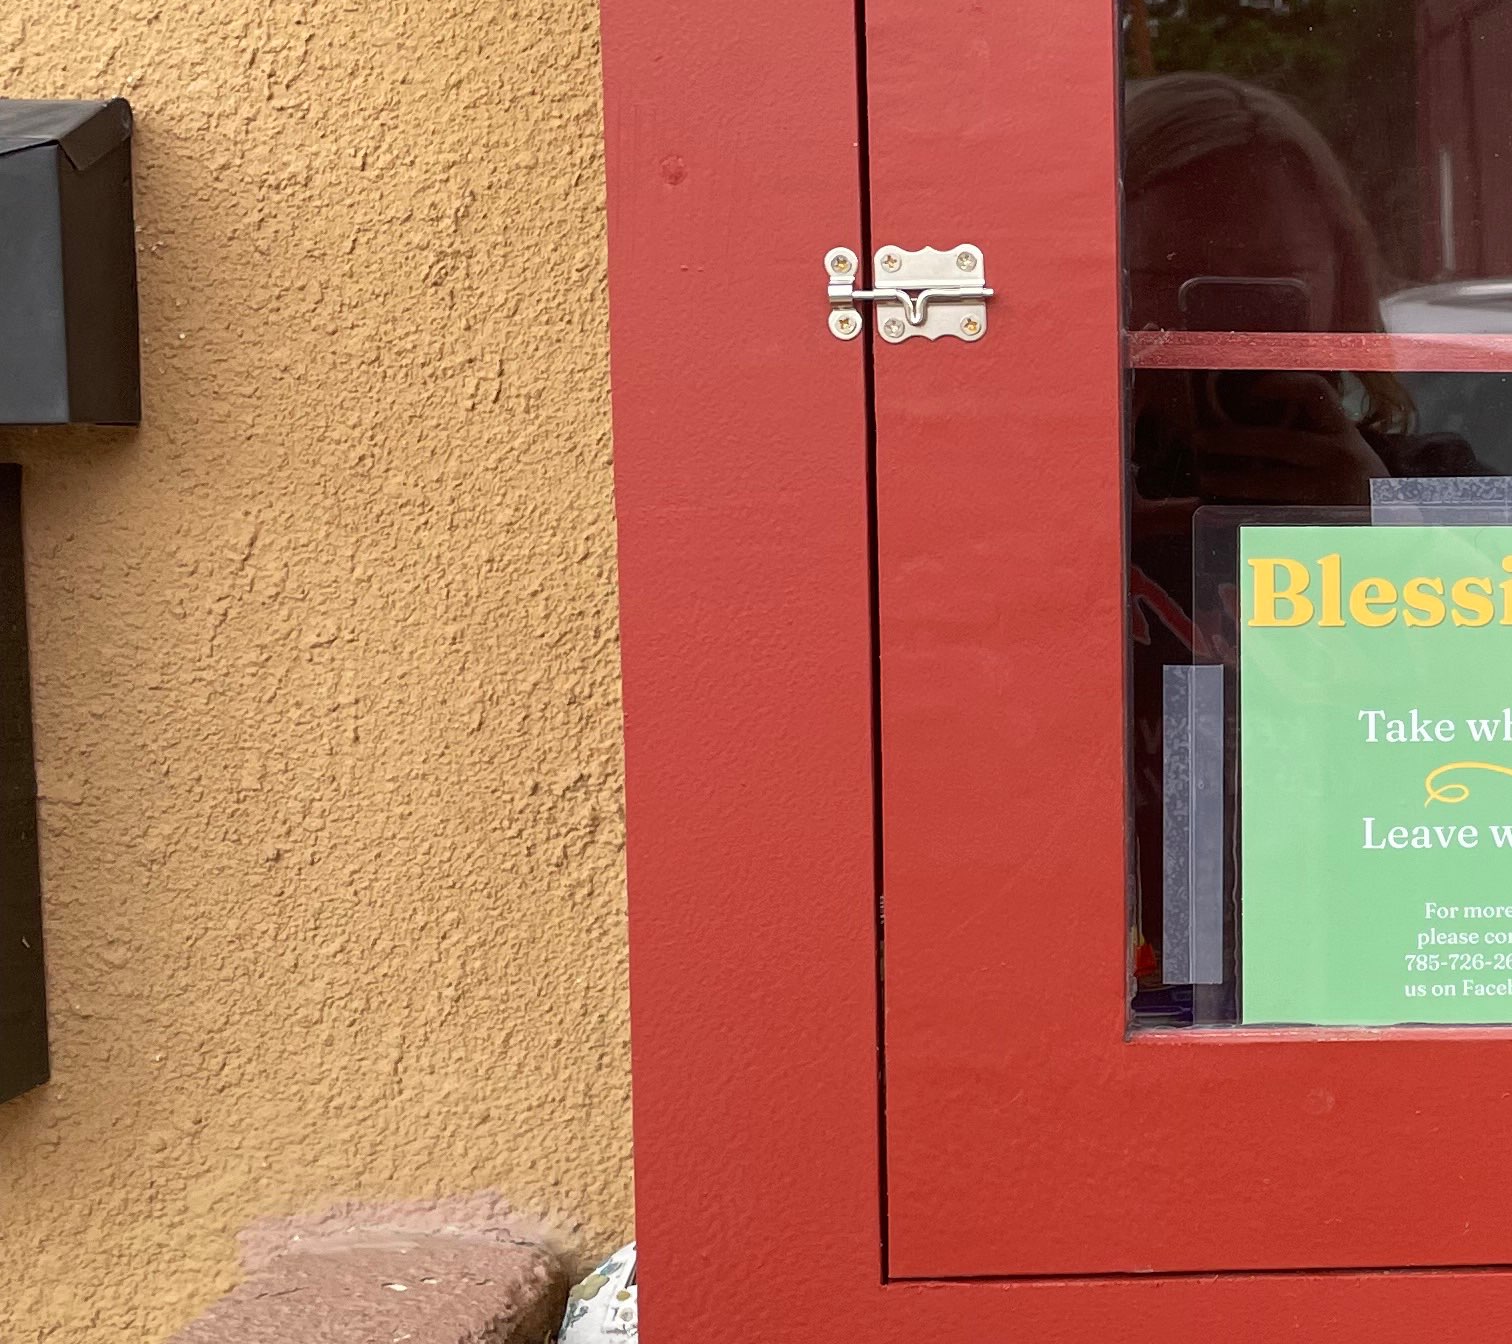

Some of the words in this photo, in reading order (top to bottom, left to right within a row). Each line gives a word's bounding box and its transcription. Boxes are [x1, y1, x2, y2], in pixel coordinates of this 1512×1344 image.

[1358, 709, 1456, 744] Take
[1363, 818, 1480, 851] Leave
[1424, 903, 1460, 919] For
[1417, 928, 1480, 950] please
[1404, 984, 1428, 998] us
[1431, 984, 1457, 998] on
